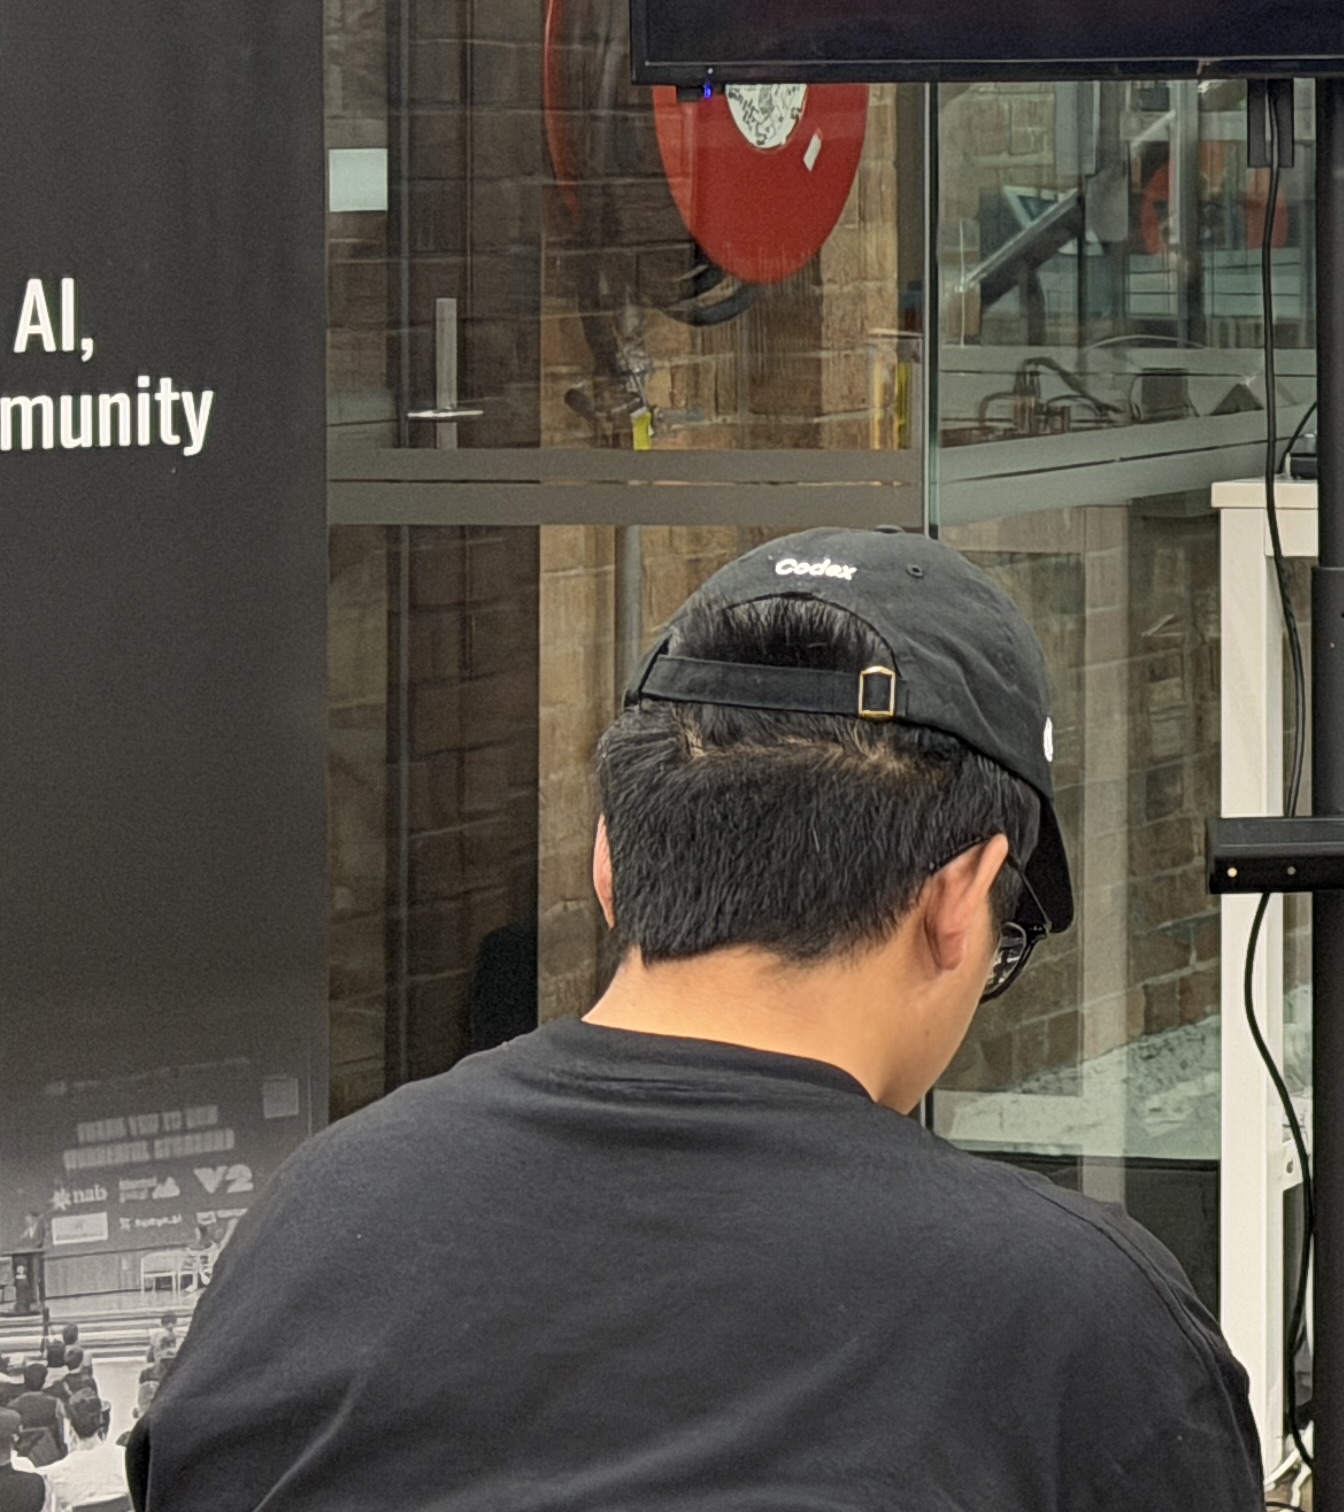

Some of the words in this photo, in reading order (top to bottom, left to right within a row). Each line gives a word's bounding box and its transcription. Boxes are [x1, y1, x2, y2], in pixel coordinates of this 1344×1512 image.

[13, 277, 94, 363] AI,
[775, 557, 858, 581] Codex
[73, 1184, 108, 1203] nab
